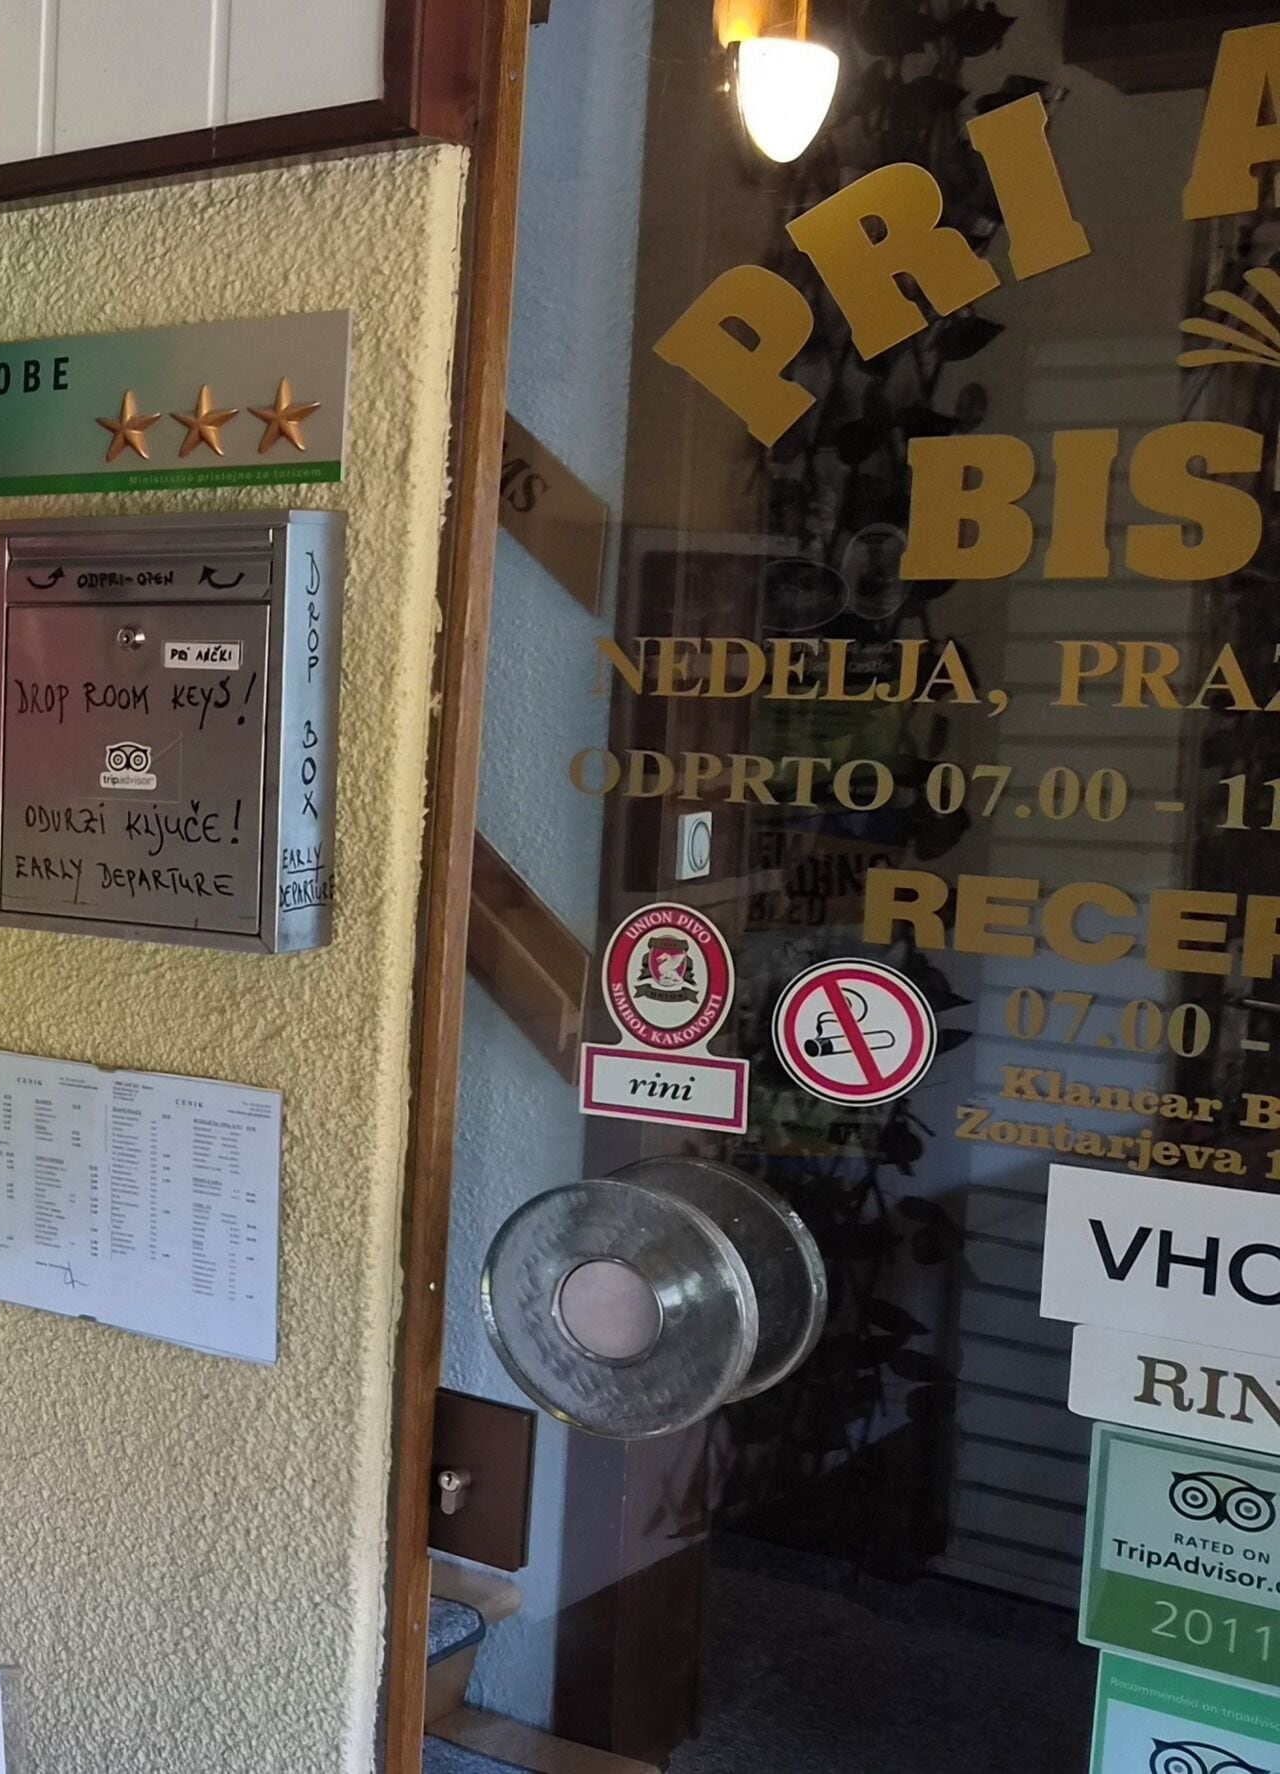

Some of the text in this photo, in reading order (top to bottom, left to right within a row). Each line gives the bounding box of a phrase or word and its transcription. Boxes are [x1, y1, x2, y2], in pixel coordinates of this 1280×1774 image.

[652, 92, 1090, 447] PRI
[899, 420, 1262, 581] BIS
[14, 678, 70, 724] DROP
[83, 682, 150, 715] ROOM
[591, 636, 1009, 718] NEDELJA,
[102, 774, 155, 787] tripadvisor
[568, 747, 894, 812] ODPRTO
[926, 763, 1128, 822] 07.00
[16, 854, 83, 905] EARLY
[282, 842, 322, 884] EARLY
[279, 874, 334, 908] DEPARTURE
[625, 911, 712, 944] UNION PIVO
[612, 982, 722, 1046] SIMBOL KAKOVOSTI
[1004, 986, 1212, 1059] 07.00
[628, 1072, 697, 1102] rini
[1174, 1533, 1270, 1565] RATED ON
[1151, 1600, 1270, 1661] 2011
[1110, 1676, 1199, 1709] Recommended
[1202, 1704, 1218, 1714] on
